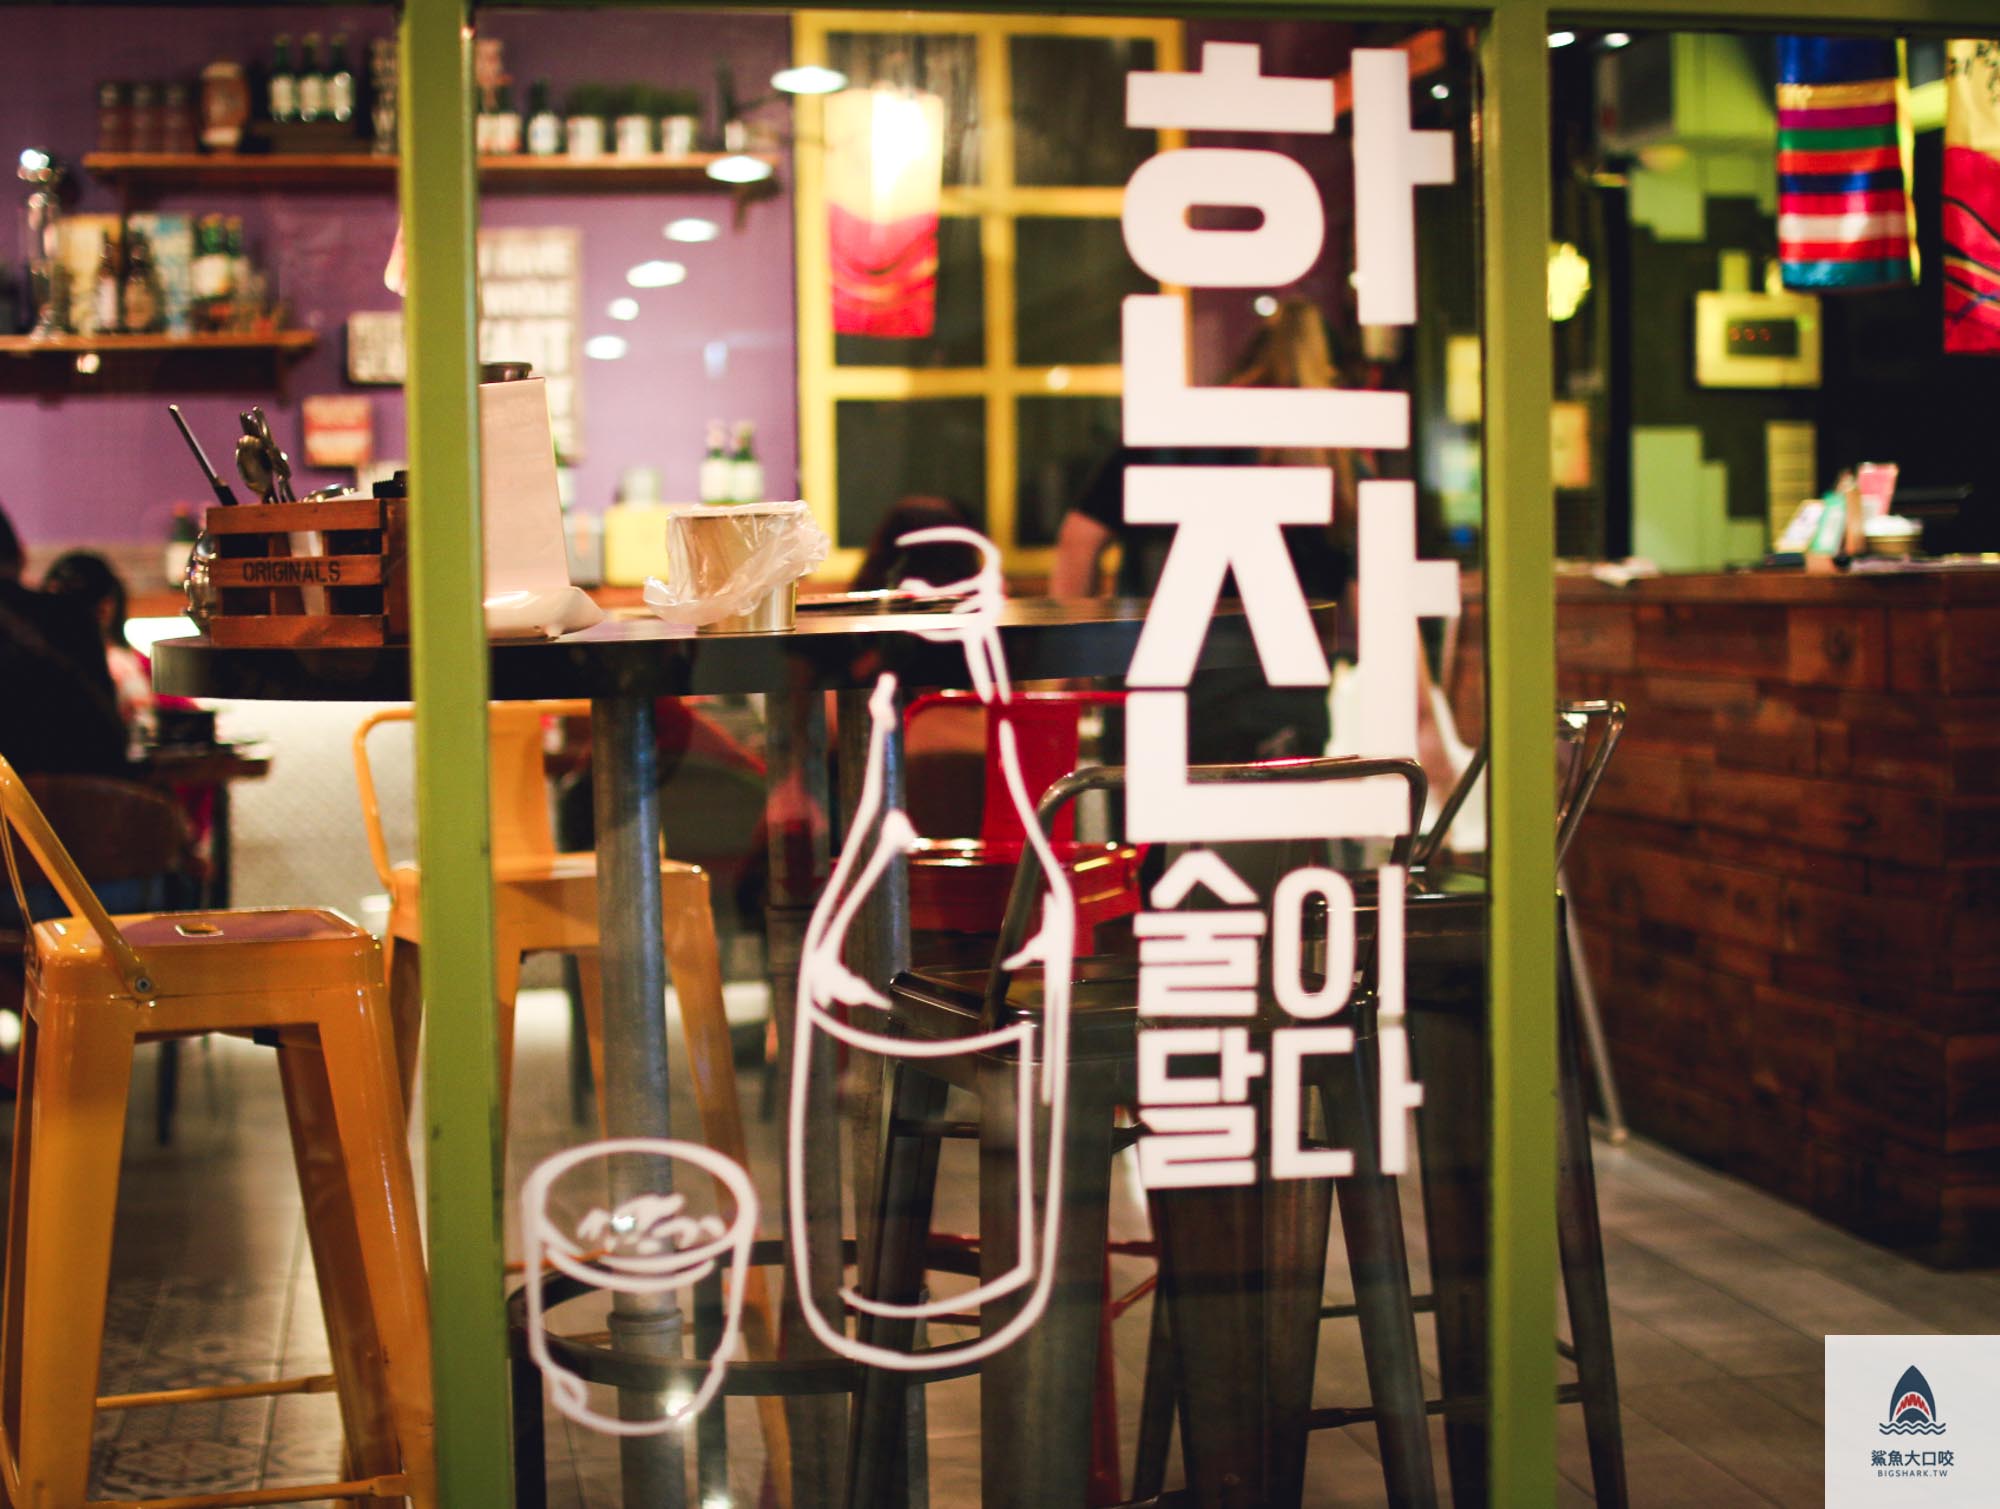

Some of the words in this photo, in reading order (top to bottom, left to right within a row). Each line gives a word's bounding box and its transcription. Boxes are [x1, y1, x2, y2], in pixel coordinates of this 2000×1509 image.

[242, 560, 341, 583] ORIGINALS
[1133, 849, 1407, 1019] 술이
[1137, 1025, 1424, 1190] 달다
